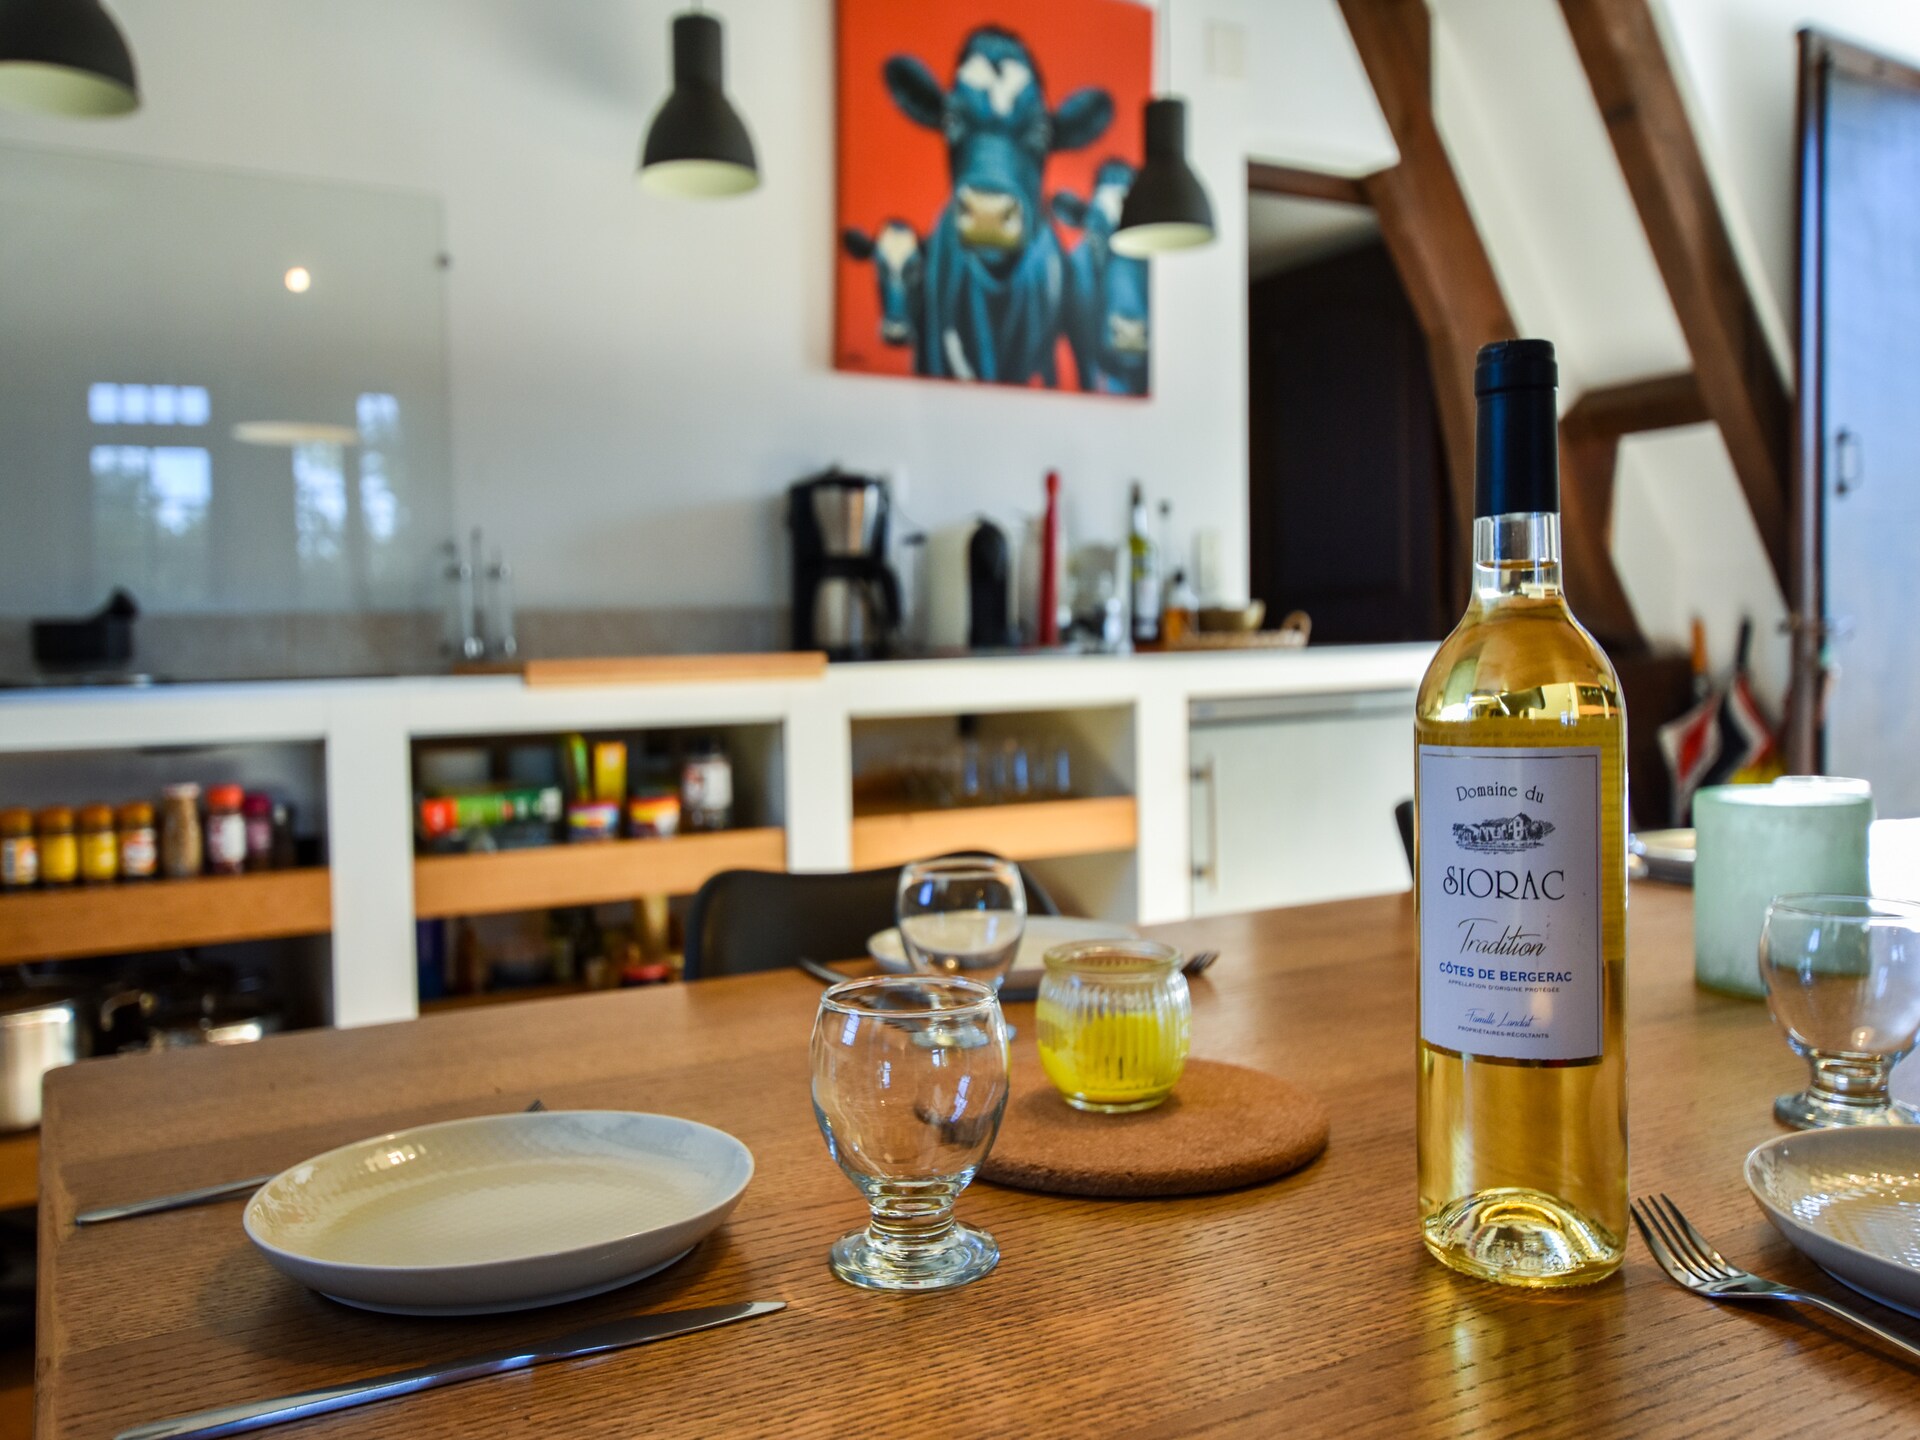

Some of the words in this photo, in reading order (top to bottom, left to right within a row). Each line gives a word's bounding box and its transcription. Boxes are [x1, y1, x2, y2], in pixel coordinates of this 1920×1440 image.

[1456, 782, 1518, 801] Domaine
[1525, 785, 1545, 803] du
[1443, 865, 1565, 901] SIORAC
[1457, 917, 1547, 957] Tradition
[1439, 961, 1474, 977] CÔTES
[1478, 968, 1496, 980] DE
[1500, 971, 1573, 983] BERGERAC
[1448, 980, 1487, 989] APPELLATION
[1465, 1008, 1496, 1026] Famille
